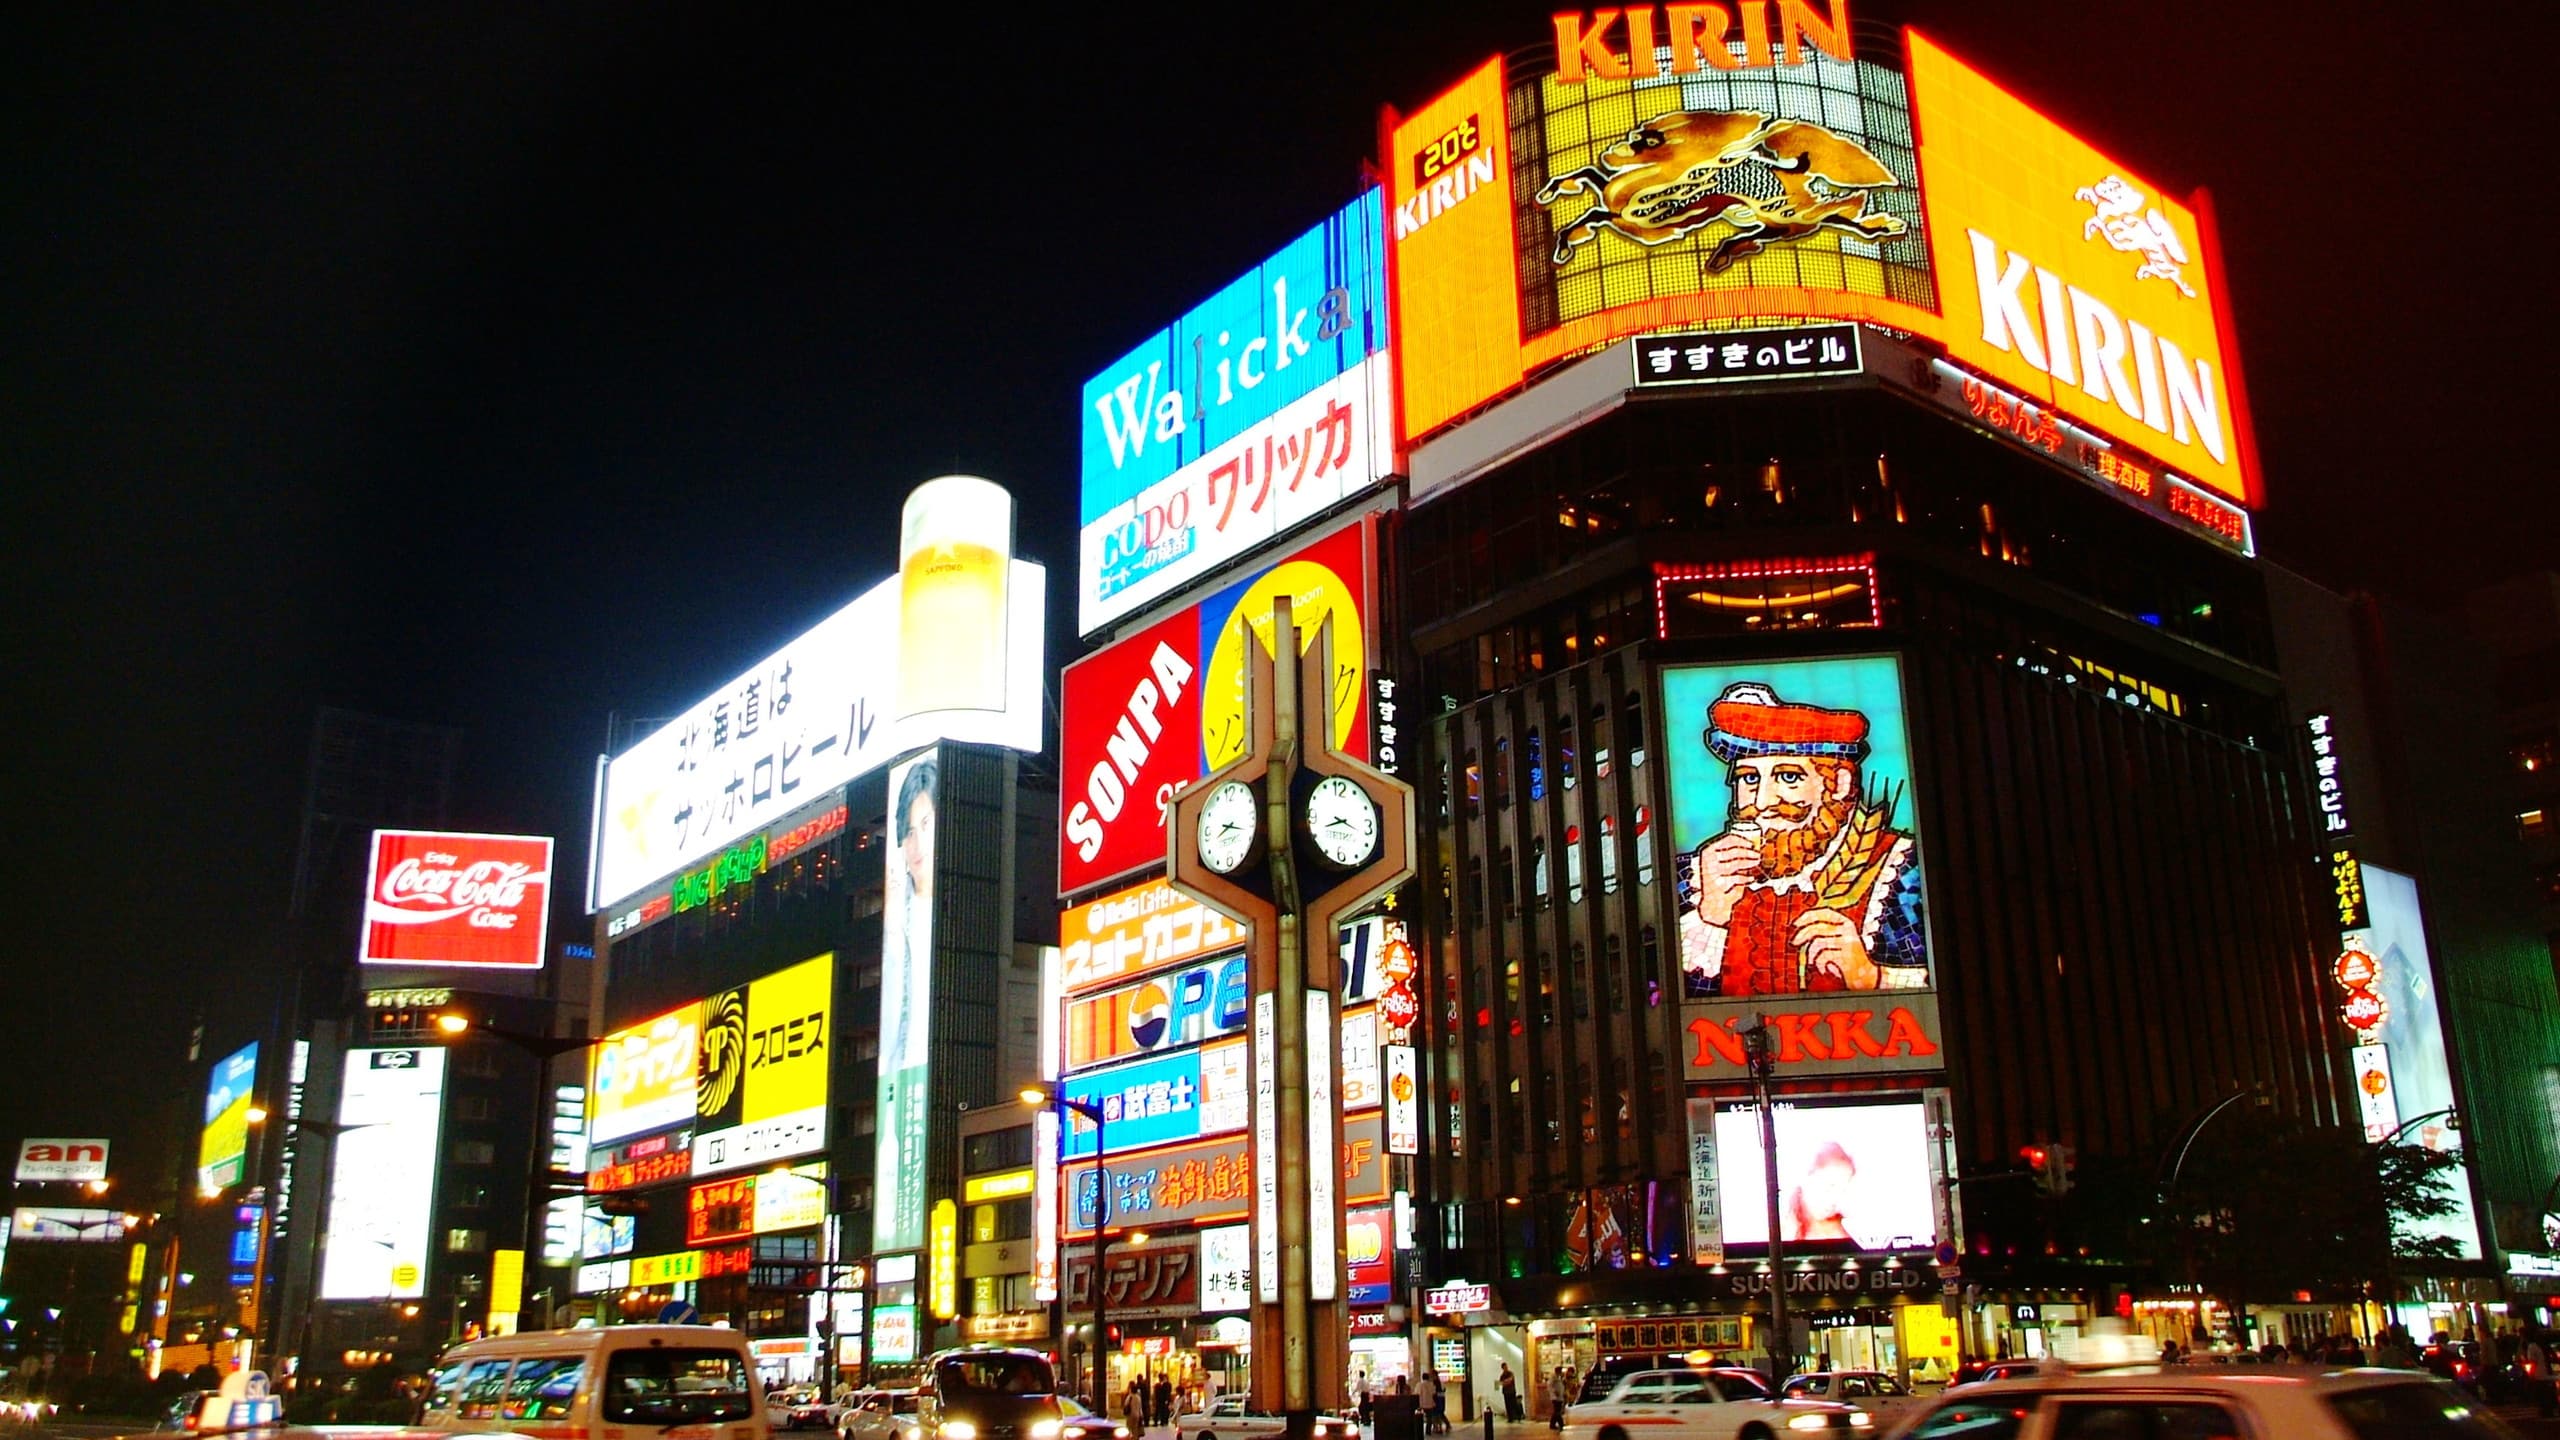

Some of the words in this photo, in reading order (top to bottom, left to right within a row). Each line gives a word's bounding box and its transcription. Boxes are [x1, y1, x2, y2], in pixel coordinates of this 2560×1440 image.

[1554, 0, 1854, 84] KIRIN
[1395, 145, 1495, 241] KIRIN
[1096, 276, 1354, 469] Walicka
[1648, 336, 1847, 374] すすきのビル
[1967, 228, 2226, 465] KIRIN
[1208, 398, 1352, 532] ワリッカ
[677, 659, 793, 772] 北海道は
[674, 697, 875, 850] サッポロビール
[1066, 640, 1193, 863] SONPA
[2309, 715, 2347, 831] すすきのビル
[1332, 780, 1347, 799] 12
[1337, 846, 1347, 862] 6
[1364, 818, 1373, 836] 3
[382, 858, 530, 908] Coca-Cola
[1065, 903, 1247, 986] ネットカフェ
[751, 1010, 824, 1070] プロミス
[1687, 1007, 1938, 1067] NKKA
[1122, 1075, 1195, 1121] 武富士
[25, 1145, 104, 1162] an
[1695, 1135, 1716, 1216] 北海道新聞
[1068, 1252, 1191, 1304] ロテリア
[1871, 1269, 1927, 1290] BLD.
[1357, 1313, 1385, 1328] STORE
